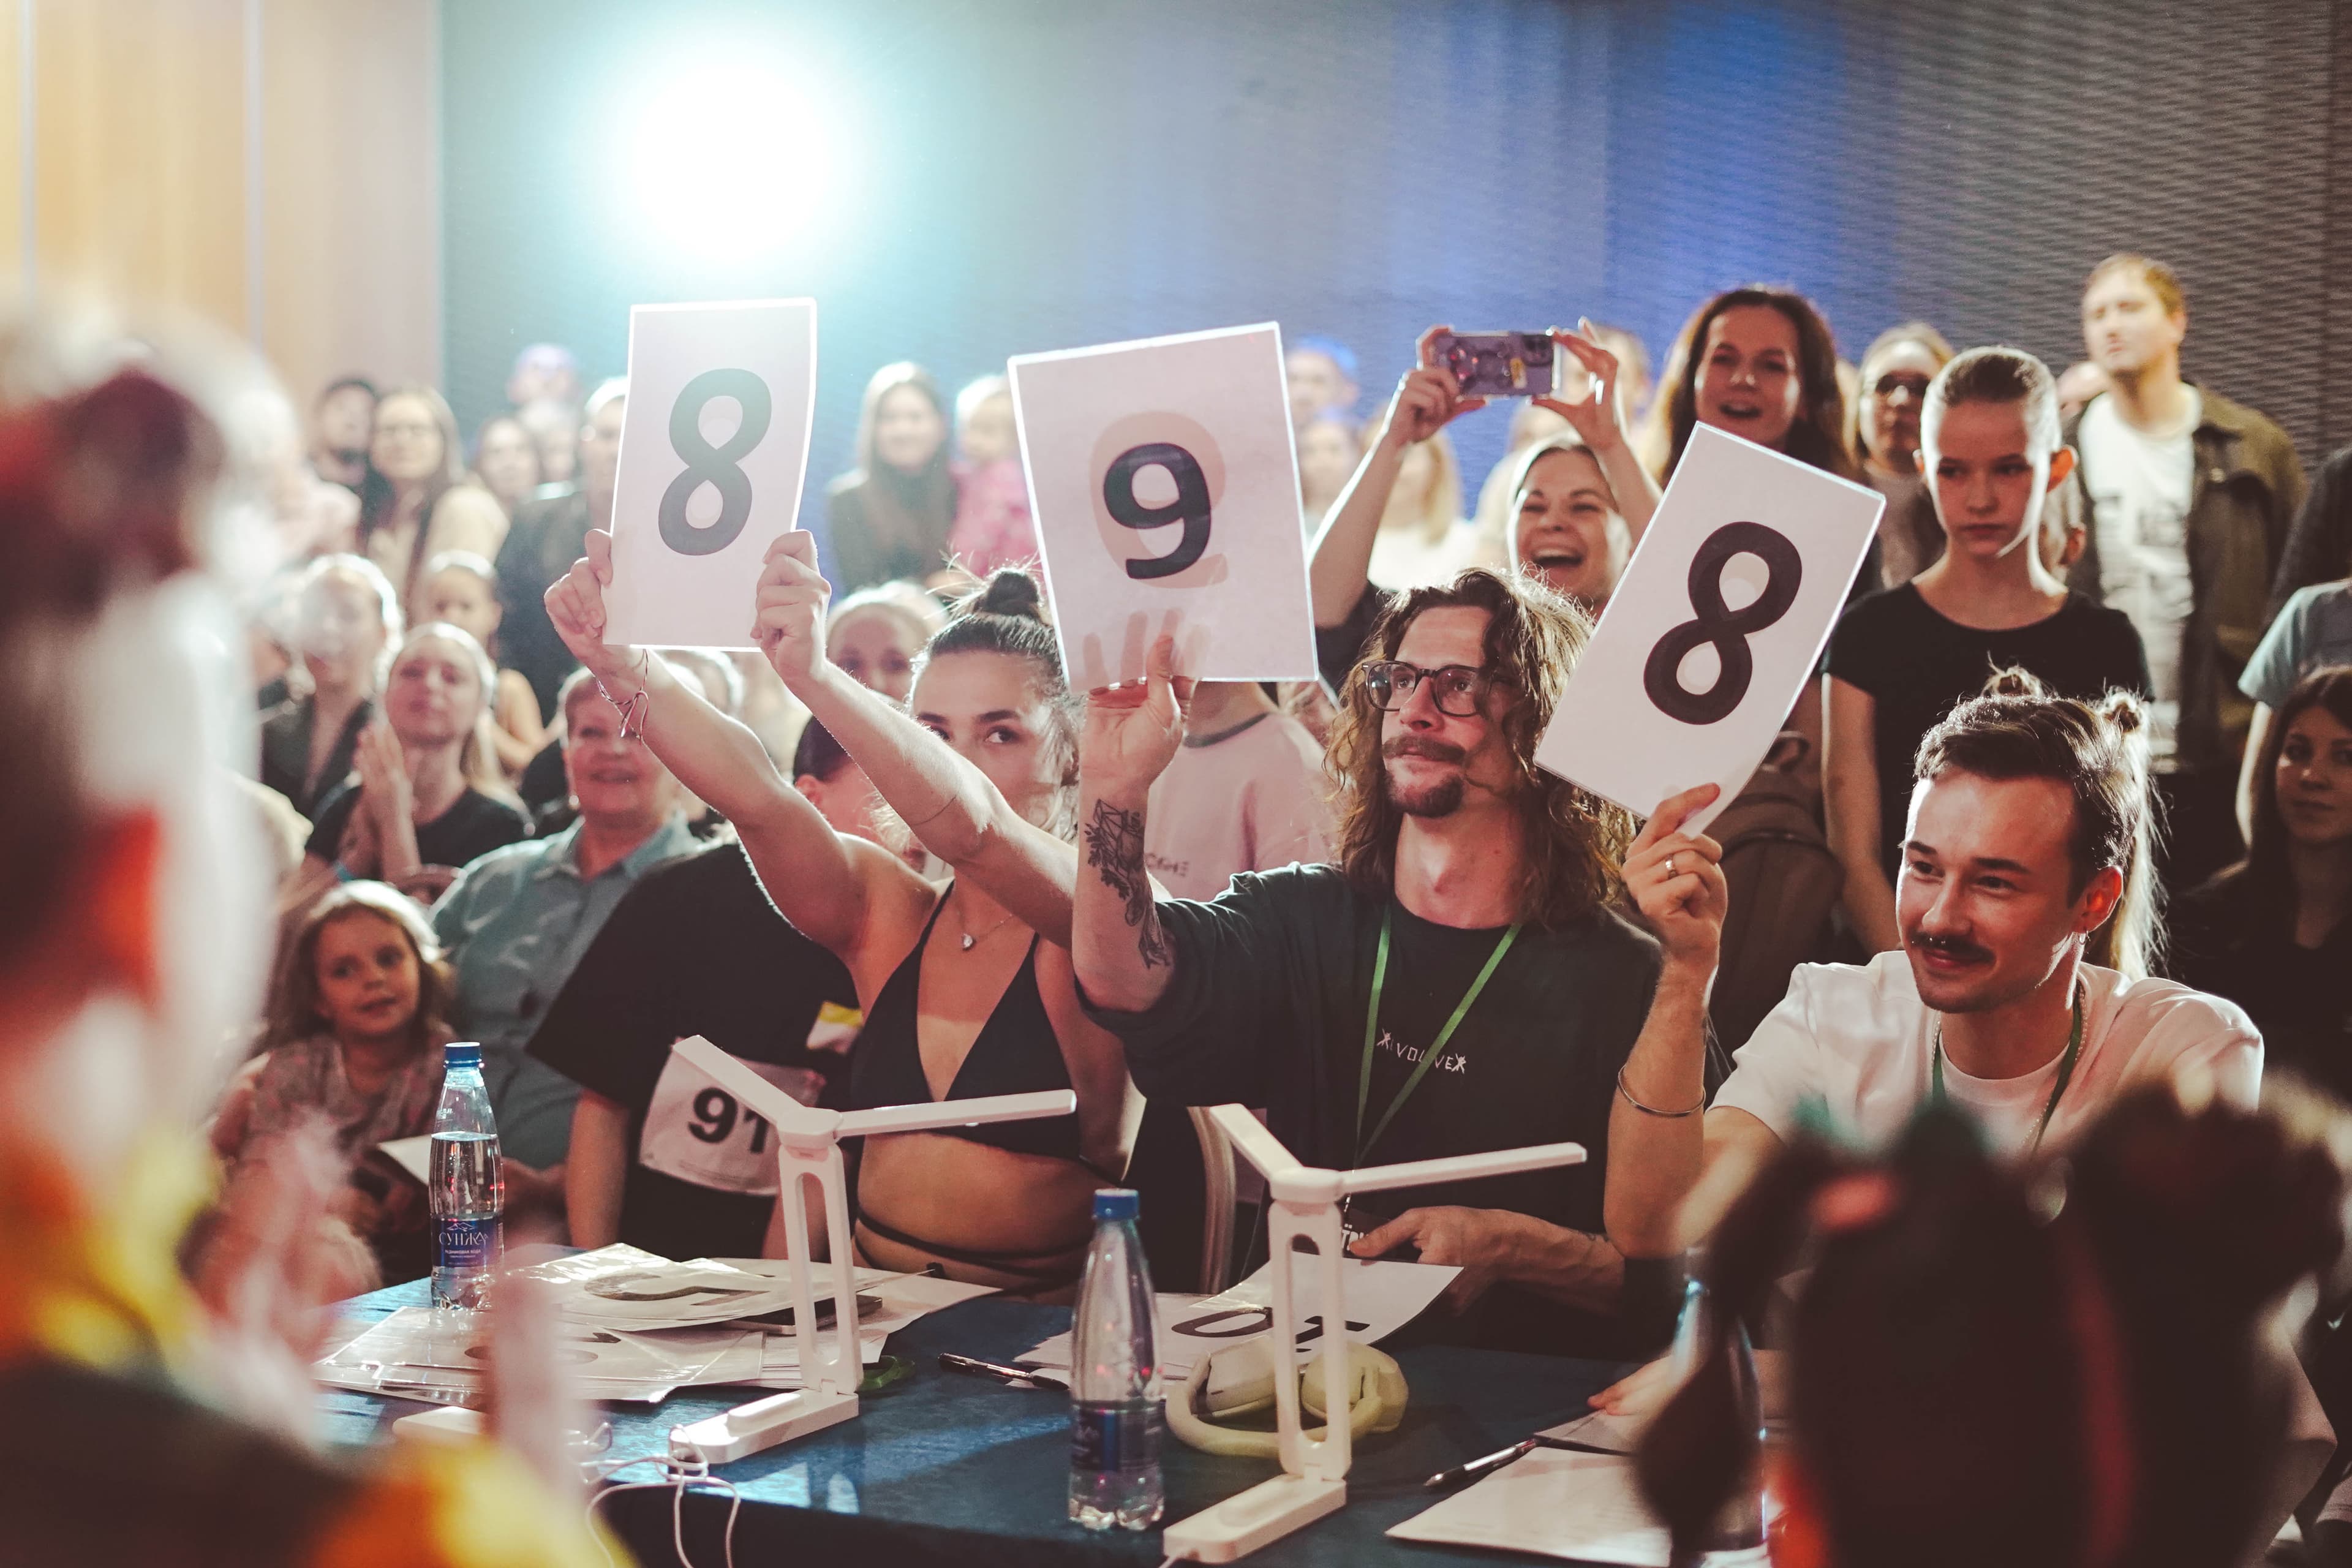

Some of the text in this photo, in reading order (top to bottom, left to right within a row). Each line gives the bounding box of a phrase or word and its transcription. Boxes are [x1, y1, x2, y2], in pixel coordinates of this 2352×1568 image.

[658, 368, 772, 556] 8
[1102, 442, 1212, 580] 9
[1643, 521, 1803, 725] 8
[687, 1087, 770, 1154] 91
[439, 1232, 486, 1245] СУНЖА
